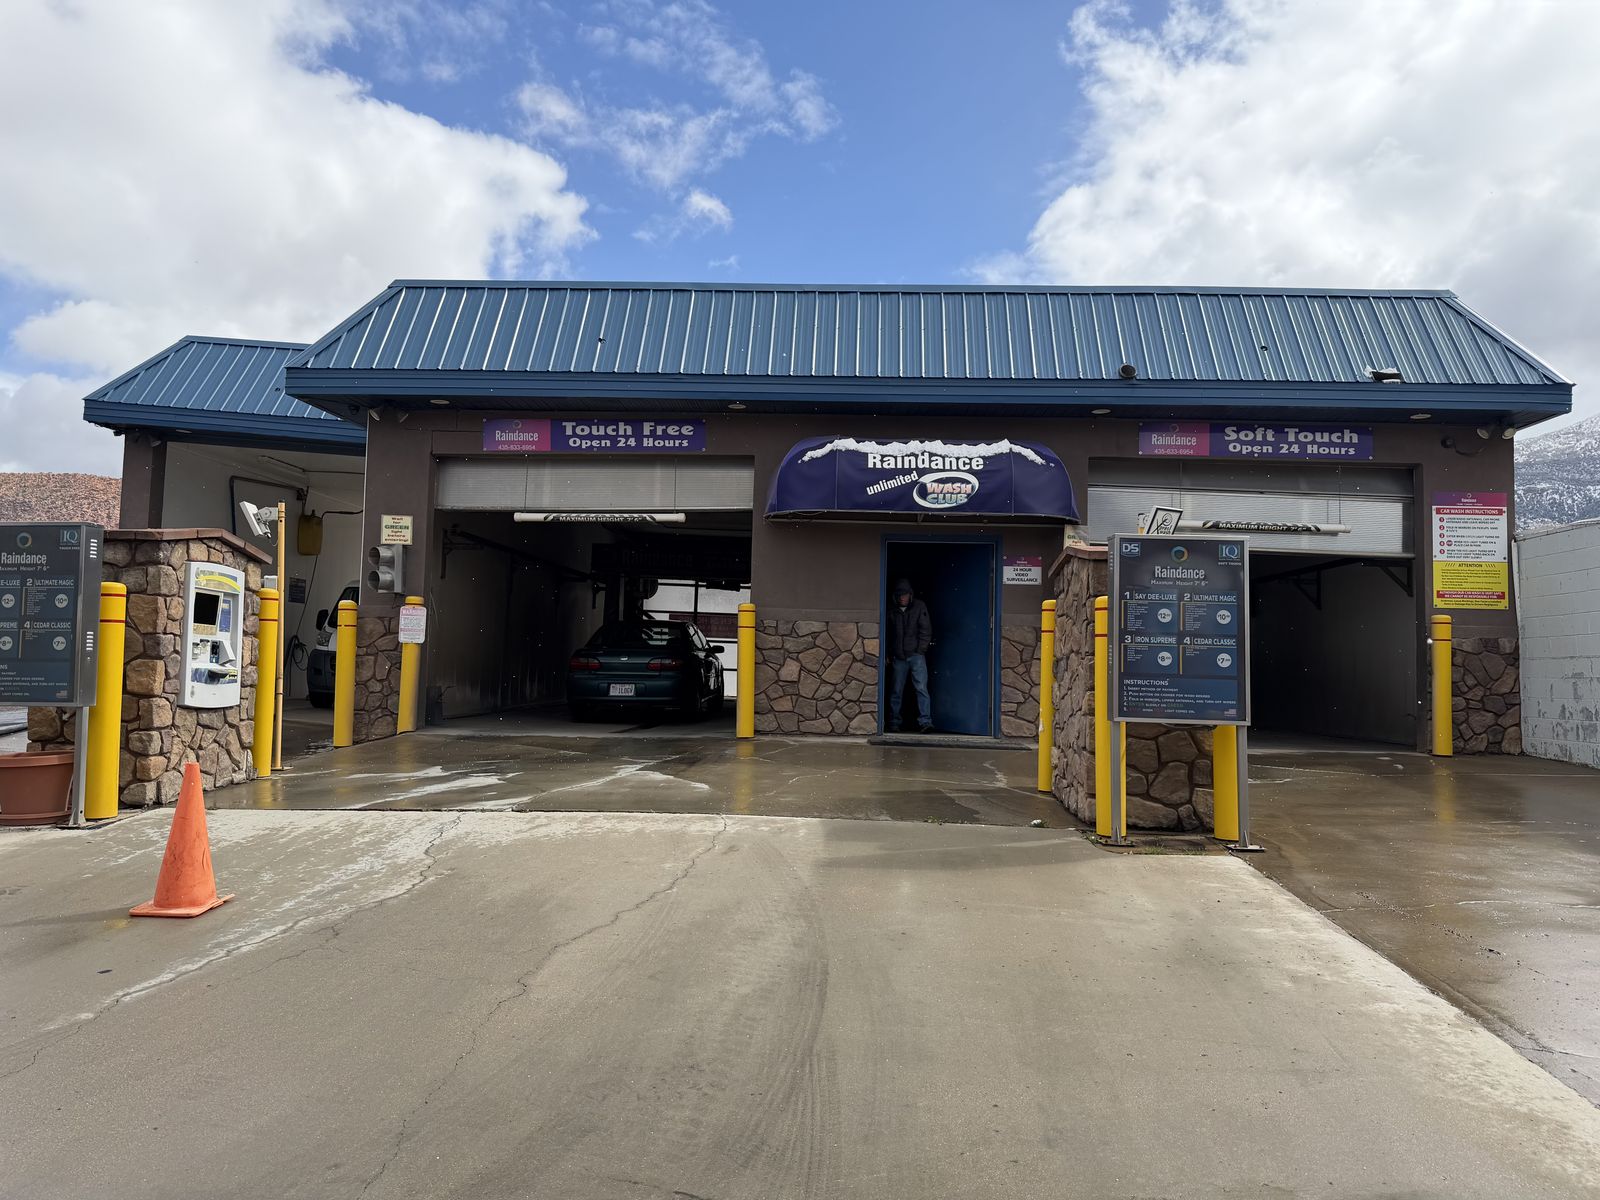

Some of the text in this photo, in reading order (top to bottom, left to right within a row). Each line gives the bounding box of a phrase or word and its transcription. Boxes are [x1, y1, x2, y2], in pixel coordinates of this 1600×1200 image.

[562, 421, 694, 436] Touch Free
[1224, 426, 1358, 443] Soft Touch
[495, 430, 539, 441] Raindance
[1151, 433, 1197, 446] Raindance
[568, 437, 689, 449] Open 24 Hours
[1228, 442, 1356, 455] Open 24 Hours
[867, 452, 984, 470] Raindance
[866, 470, 919, 496] unlimited
[925, 482, 973, 494] WASH
[925, 493, 968, 505] CLUB
[63, 530, 79, 544] IQ
[1123, 543, 1239, 559] DS IQ
[1, 552, 47, 564] Raindance
[1154, 566, 1205, 579] Raindance
[26, 578, 33, 586] 2
[1124, 591, 1130, 600] 1
[1183, 593, 1191, 601] 2
[1193, 594, 1218, 602] ULTIMATE
[24, 620, 31, 629] 4
[1124, 635, 1131, 643] 3
[1183, 636, 1191, 645] 4
